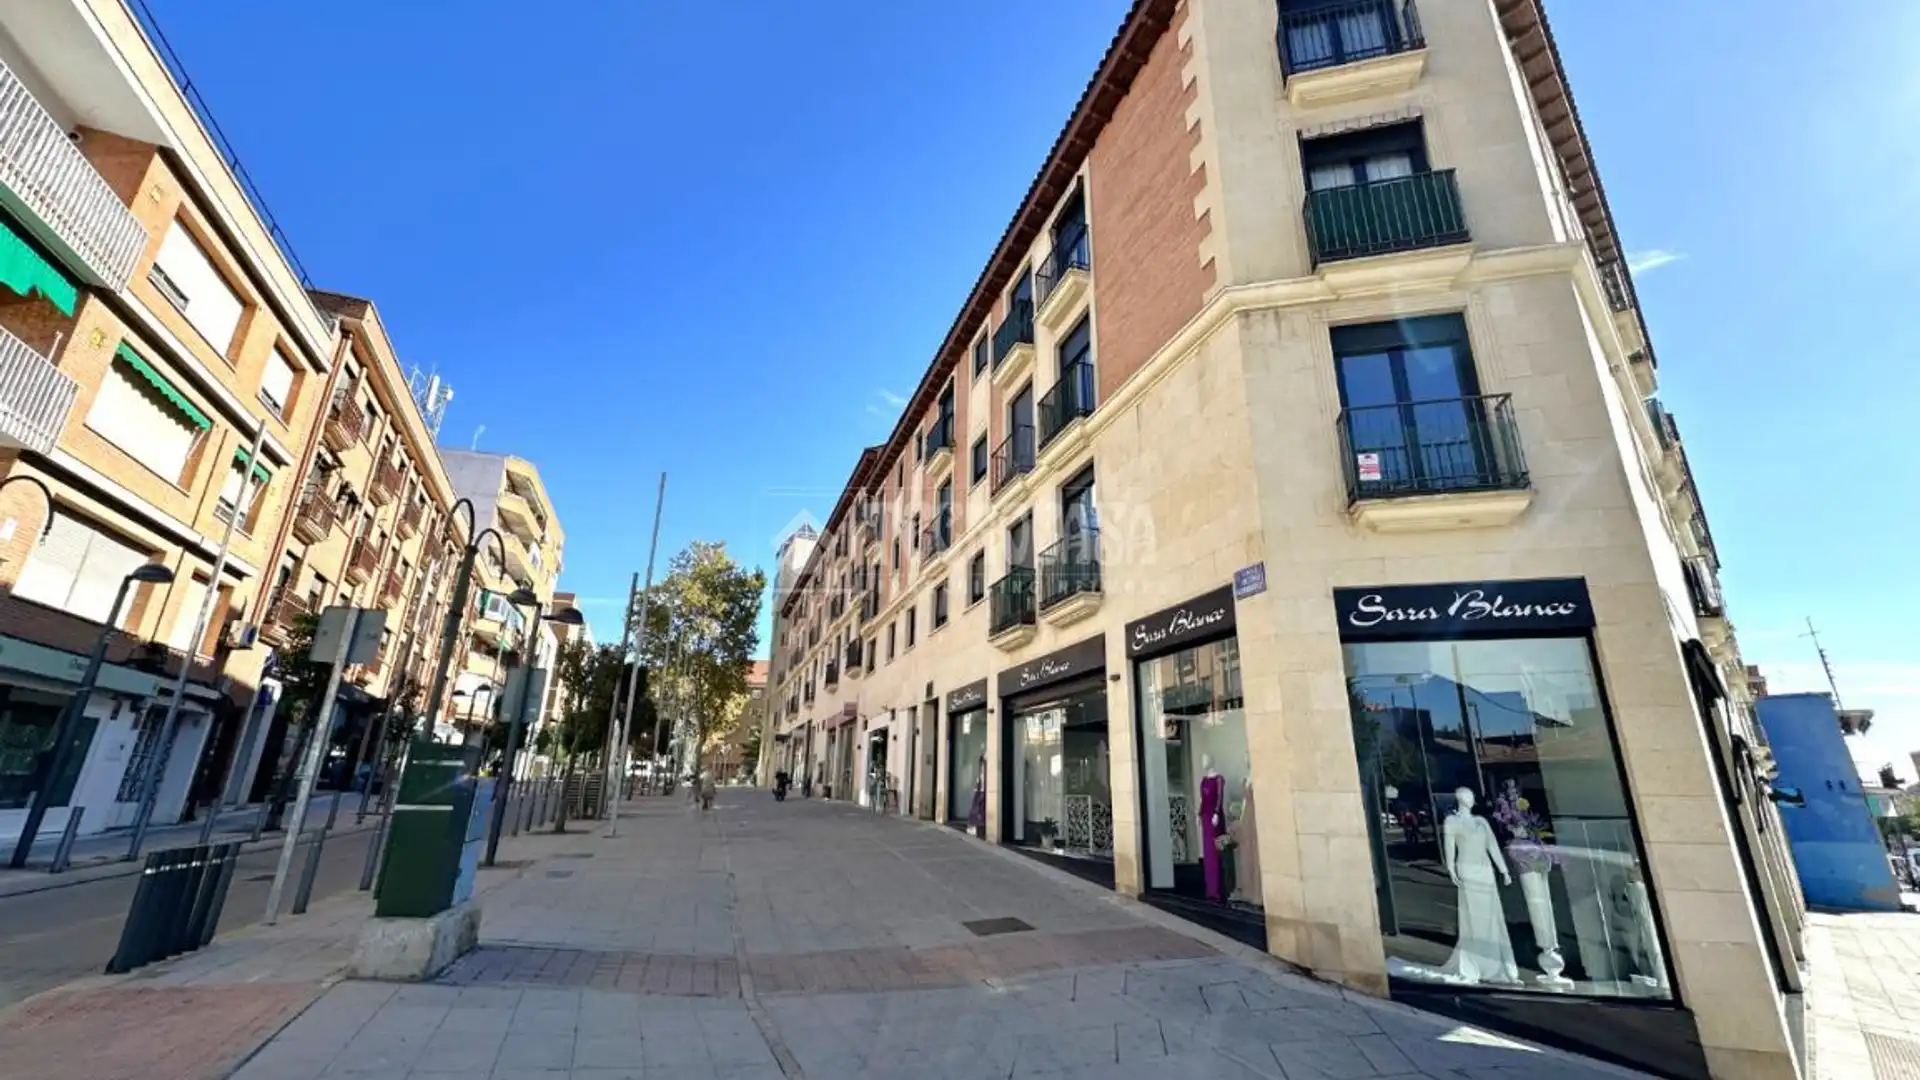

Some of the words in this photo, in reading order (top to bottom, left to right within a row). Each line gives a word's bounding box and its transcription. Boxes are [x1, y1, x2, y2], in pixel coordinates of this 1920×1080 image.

[1169, 609, 1225, 634] Blanco
[1350, 594, 1439, 626] Sara
[1448, 589, 1577, 620] Blanco
